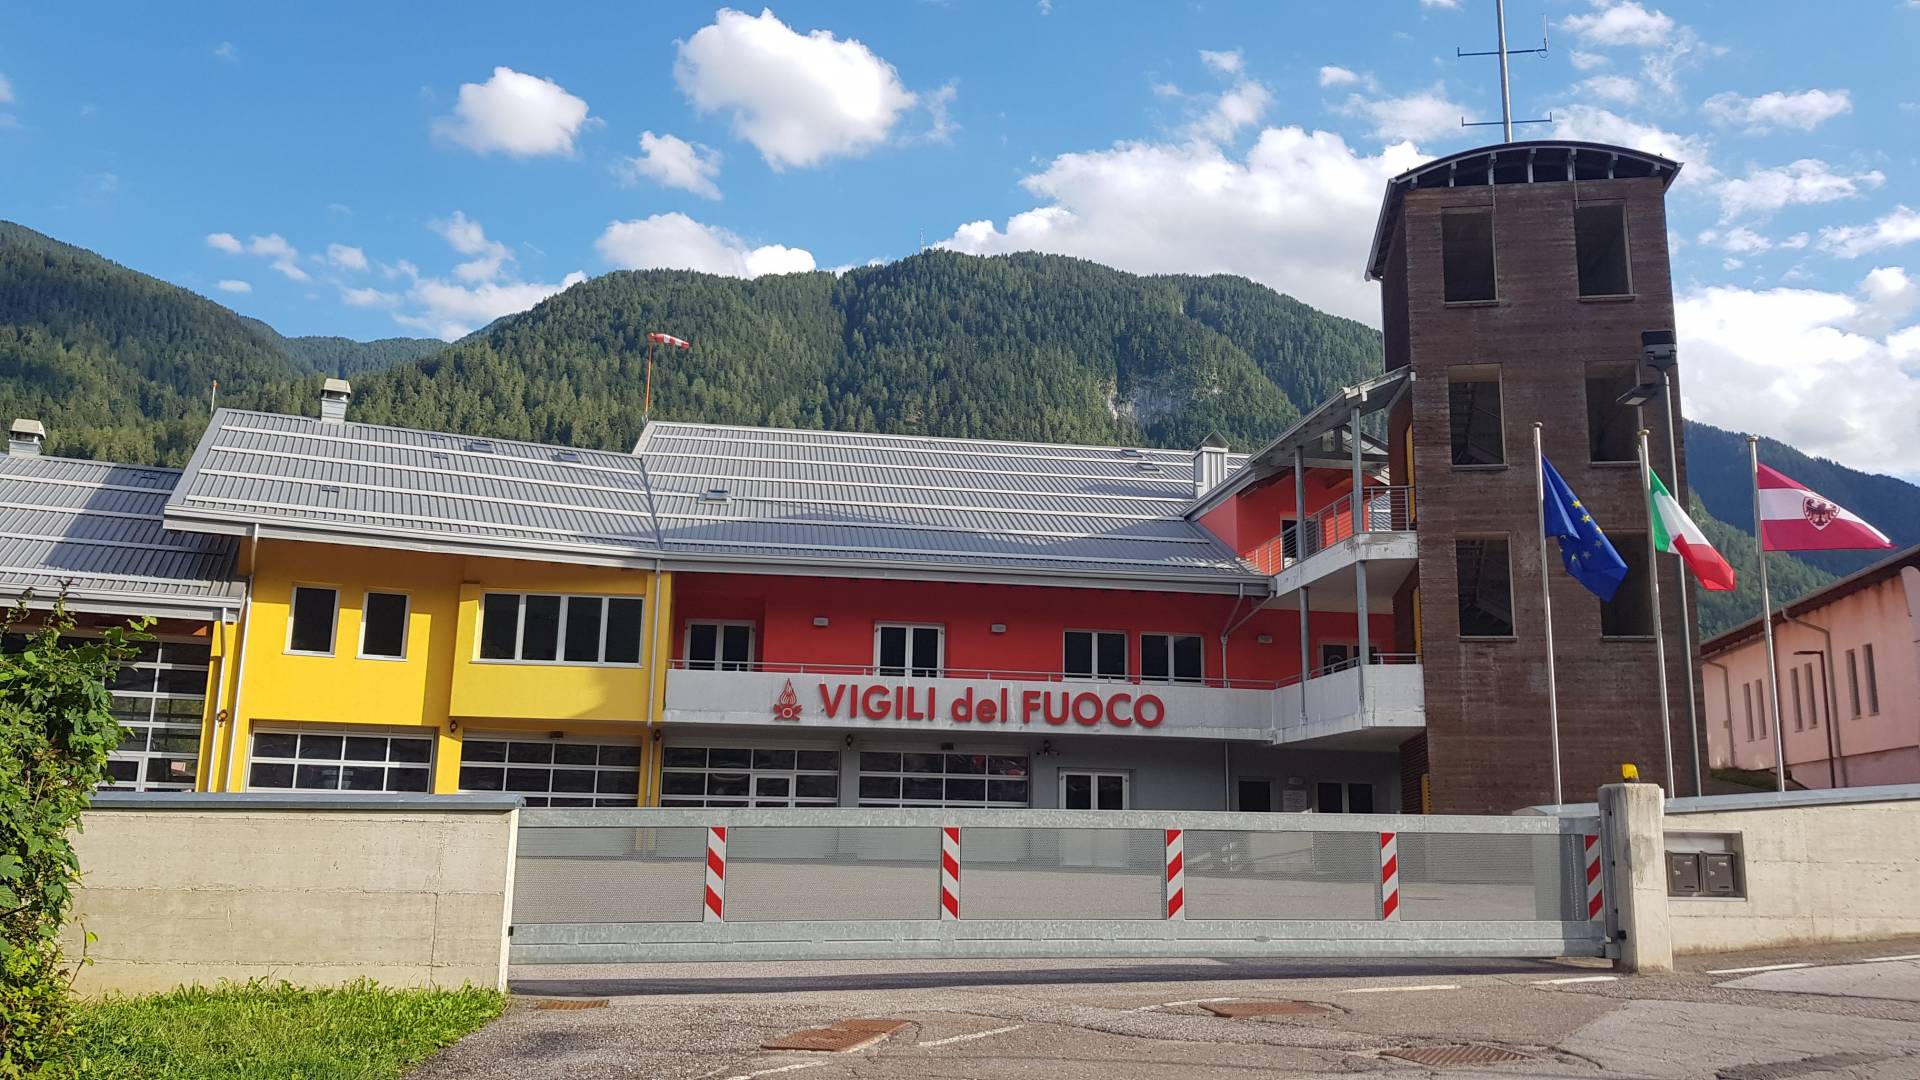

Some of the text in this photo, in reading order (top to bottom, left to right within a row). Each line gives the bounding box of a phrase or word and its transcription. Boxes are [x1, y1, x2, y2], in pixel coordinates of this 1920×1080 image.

[818, 683, 1165, 728] VIGILI del FUOCO
